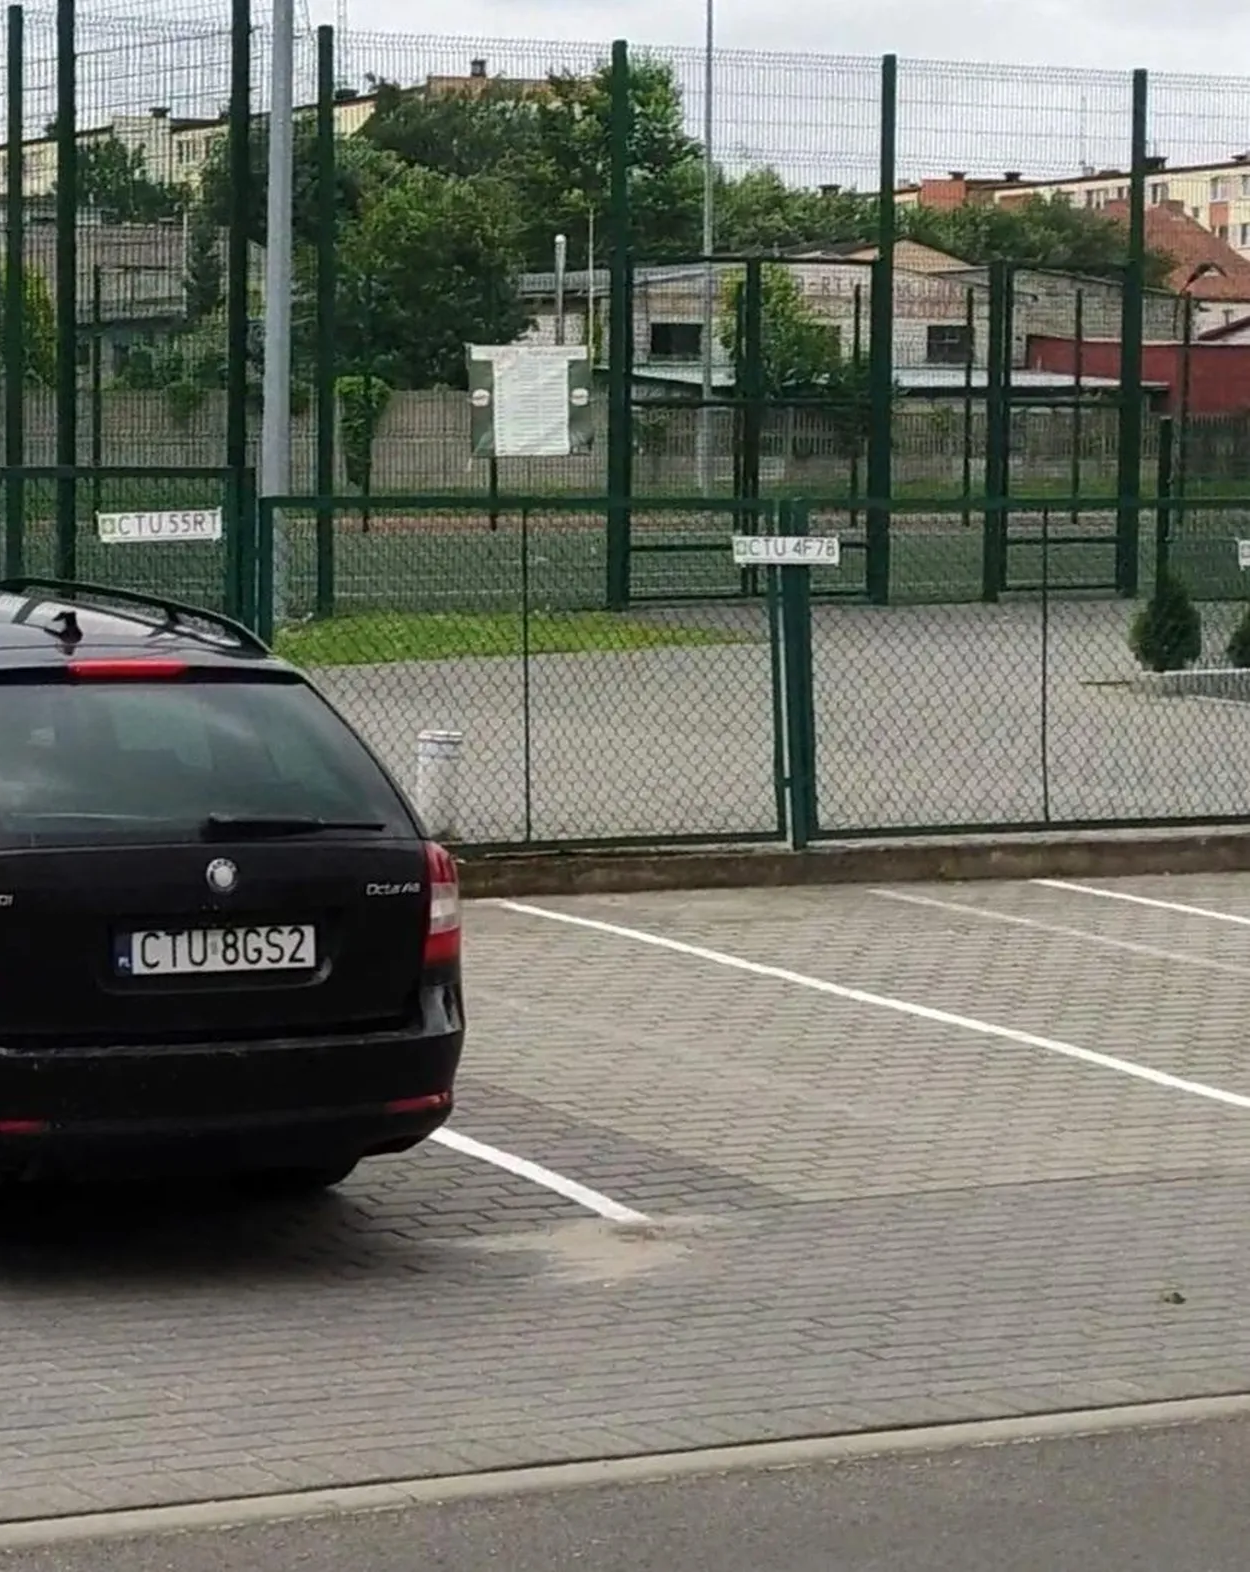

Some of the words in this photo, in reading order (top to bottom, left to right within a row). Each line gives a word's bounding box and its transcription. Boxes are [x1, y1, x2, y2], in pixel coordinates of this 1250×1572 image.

[118, 513, 163, 535] CTU
[750, 539, 787, 557] CTU
[141, 930, 208, 969] CTU
[222, 927, 306, 966] 8GS2
